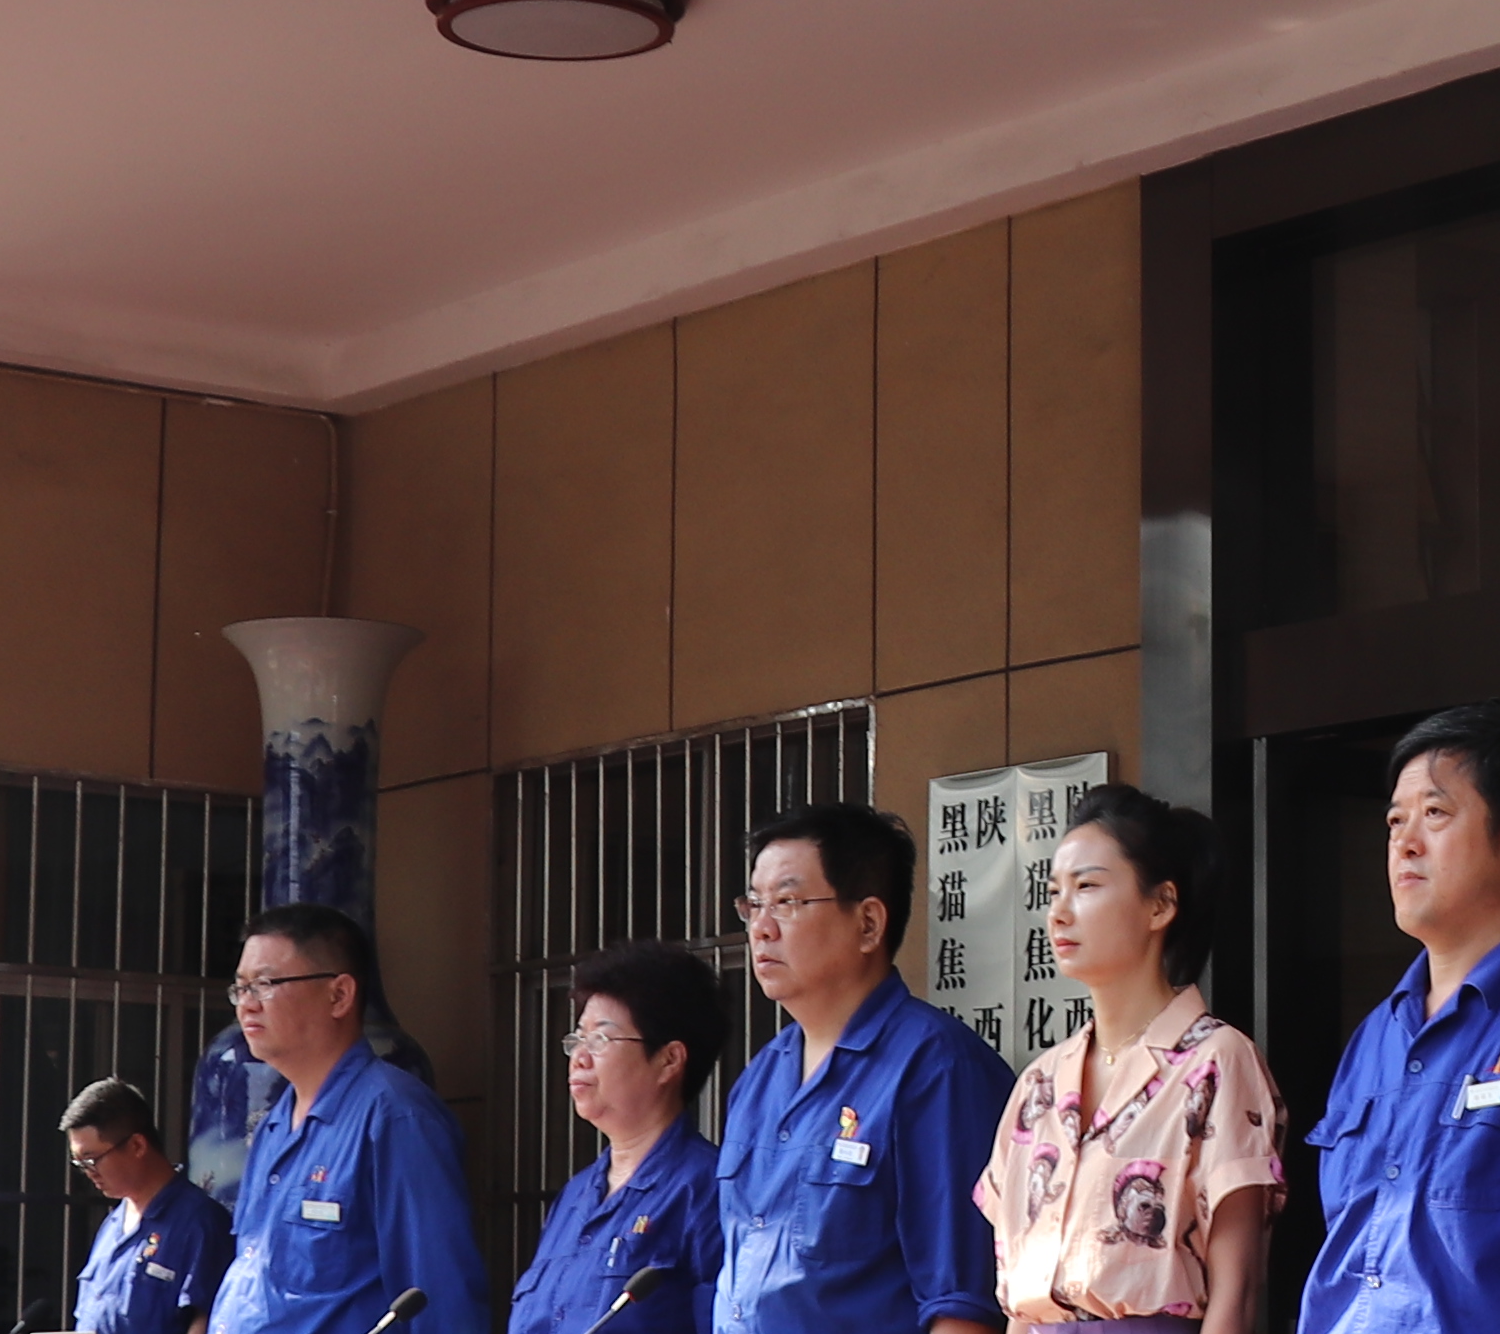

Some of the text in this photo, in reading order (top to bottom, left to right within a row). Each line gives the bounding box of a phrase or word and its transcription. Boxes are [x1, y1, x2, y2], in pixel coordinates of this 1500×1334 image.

[934, 801, 969, 1019] 黑猫焦
[1024, 787, 1056, 1051] 黑猫焦化
